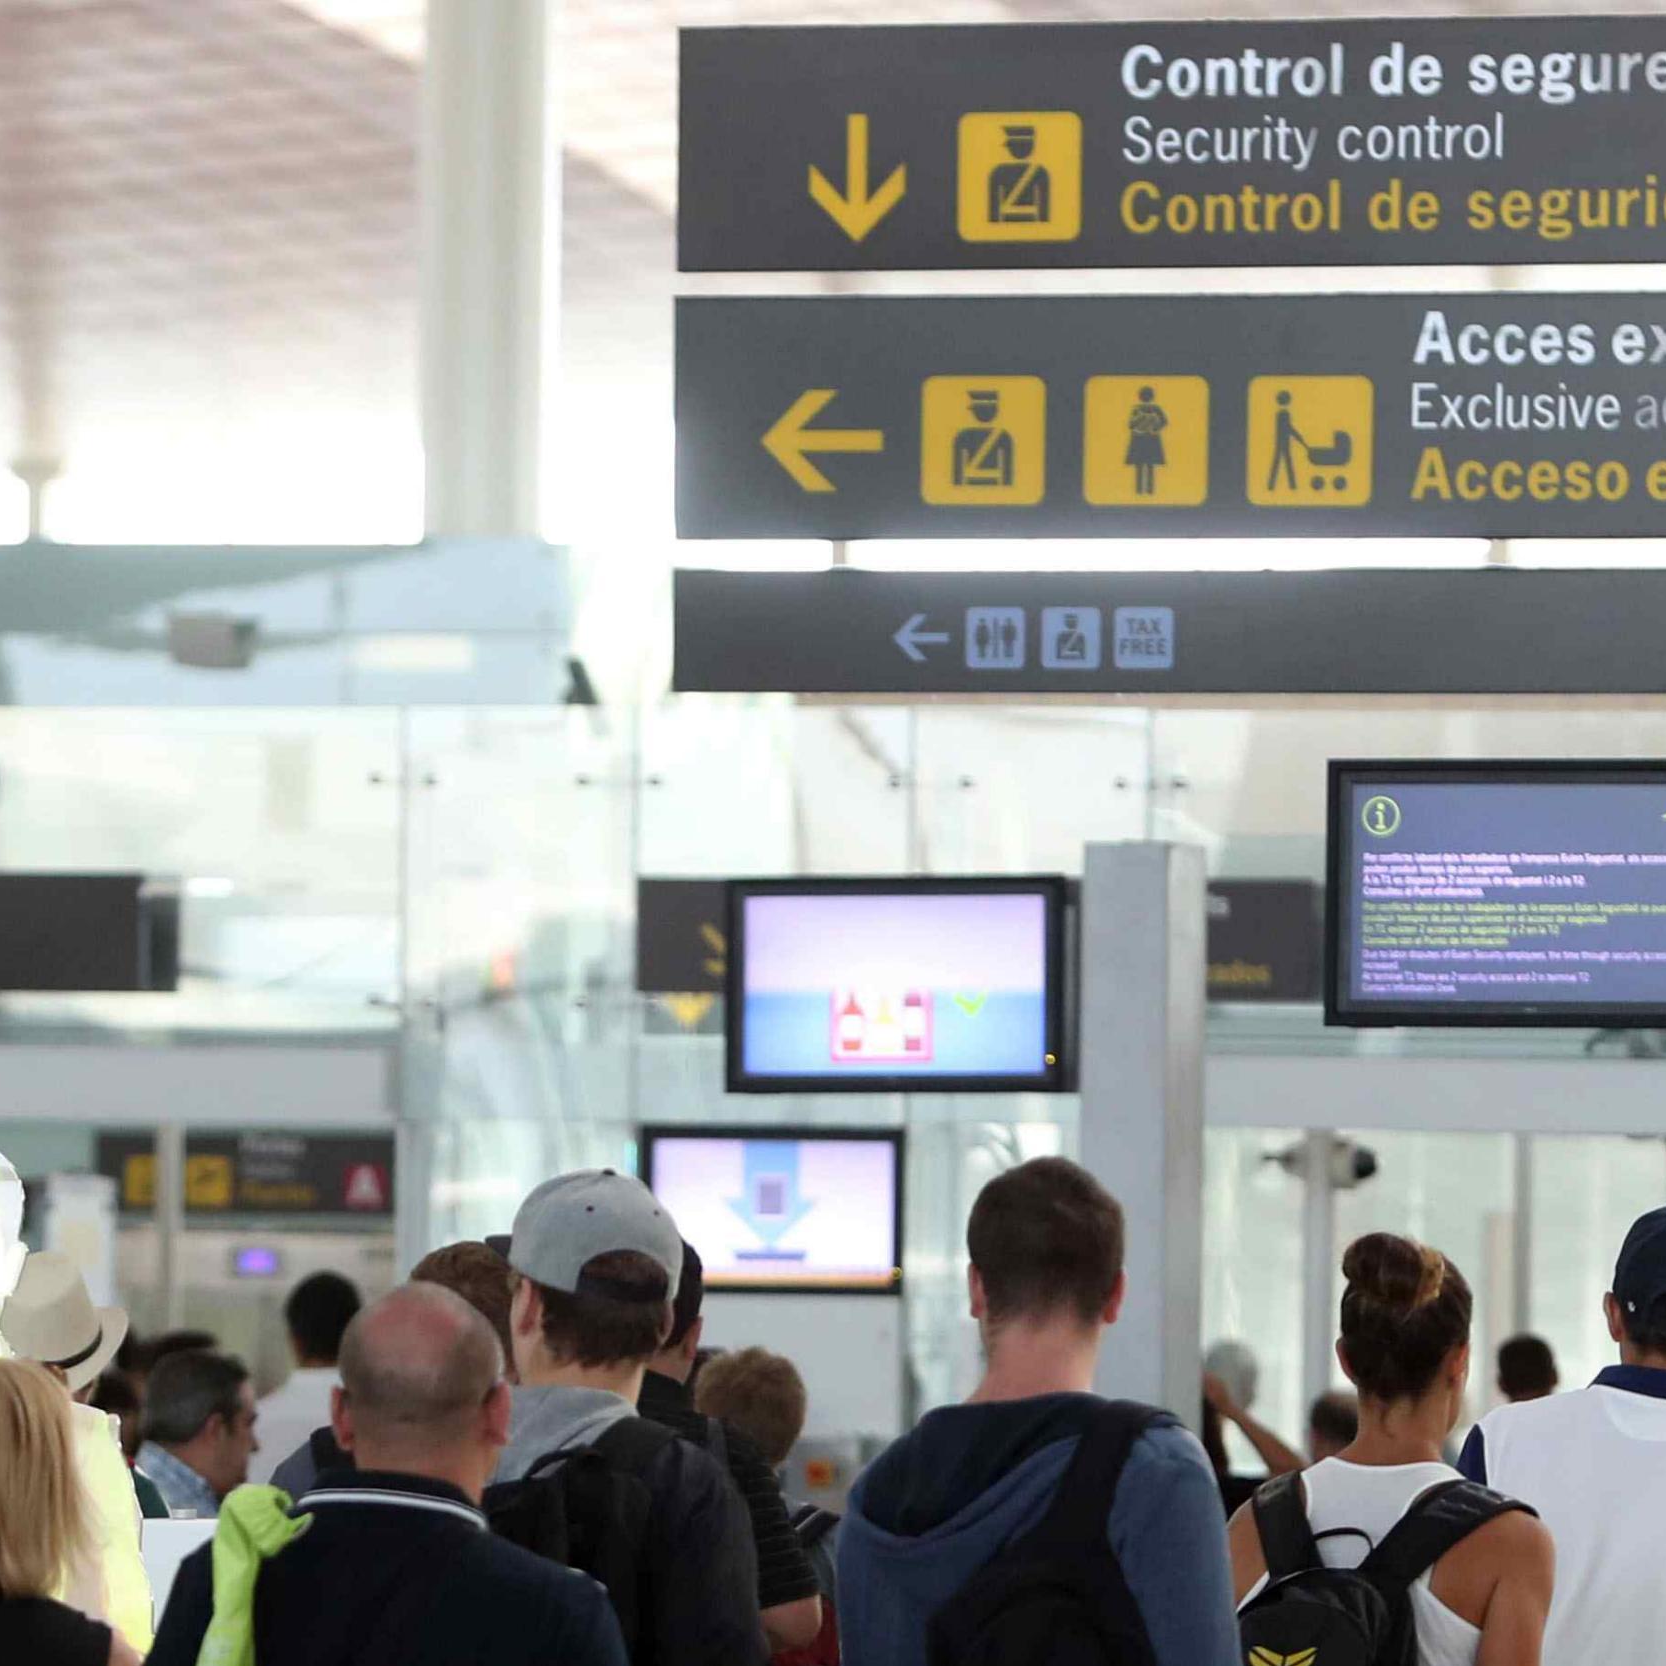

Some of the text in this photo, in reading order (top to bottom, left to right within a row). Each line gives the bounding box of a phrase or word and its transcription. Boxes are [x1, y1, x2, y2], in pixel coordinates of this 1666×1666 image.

[1121, 42, 1343, 98] Control
[1369, 42, 1443, 96] de
[1122, 112, 1505, 170] Security control
[1120, 179, 1341, 234] Control
[1368, 179, 1441, 231] de
[1411, 382, 1622, 431] Exclusive
[1411, 447, 1630, 502] Acceso
[1118, 637, 1167, 656] FREE
[1125, 617, 1164, 635] TAX
[345, 1163, 385, 1207] A
